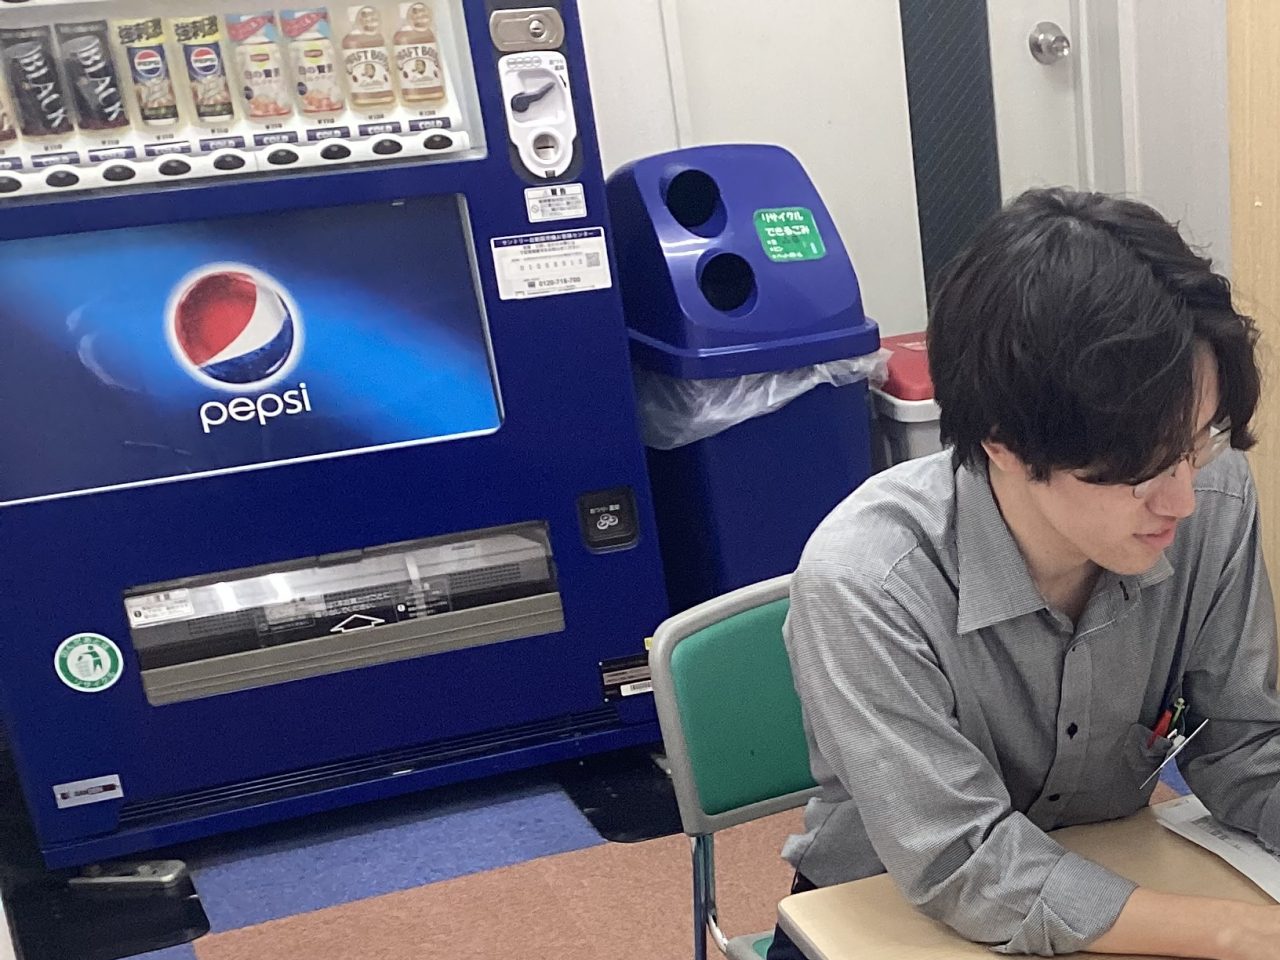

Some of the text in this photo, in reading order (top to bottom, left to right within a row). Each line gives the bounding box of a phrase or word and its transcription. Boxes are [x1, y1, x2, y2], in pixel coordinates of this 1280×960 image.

[19, 50, 66, 128] BLACK
[77, 45, 124, 121] BLACK
[761, 211, 804, 223] リサイクル
[764, 224, 810, 237] できるごみ
[200, 382, 311, 434] pepsi
